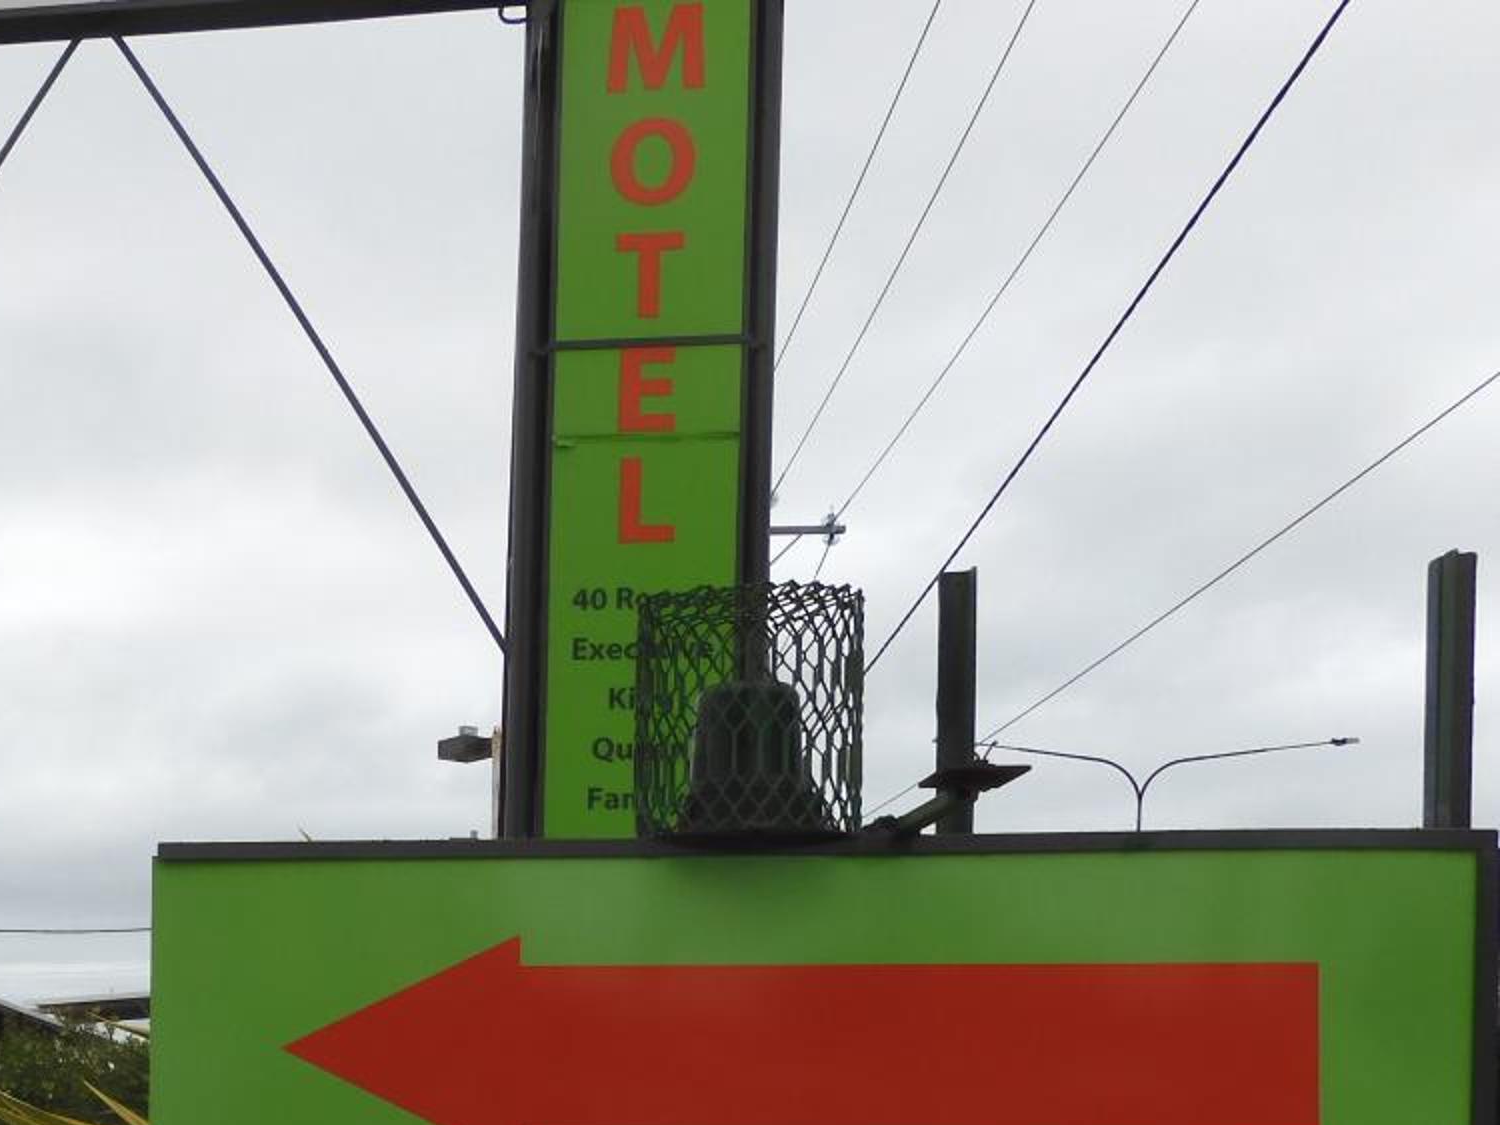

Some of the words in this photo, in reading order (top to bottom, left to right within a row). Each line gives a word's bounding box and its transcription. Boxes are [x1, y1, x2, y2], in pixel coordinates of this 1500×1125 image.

[606, 2, 705, 545] MOTEL
[572, 588, 607, 611] 40
[572, 637, 713, 661] Execive
